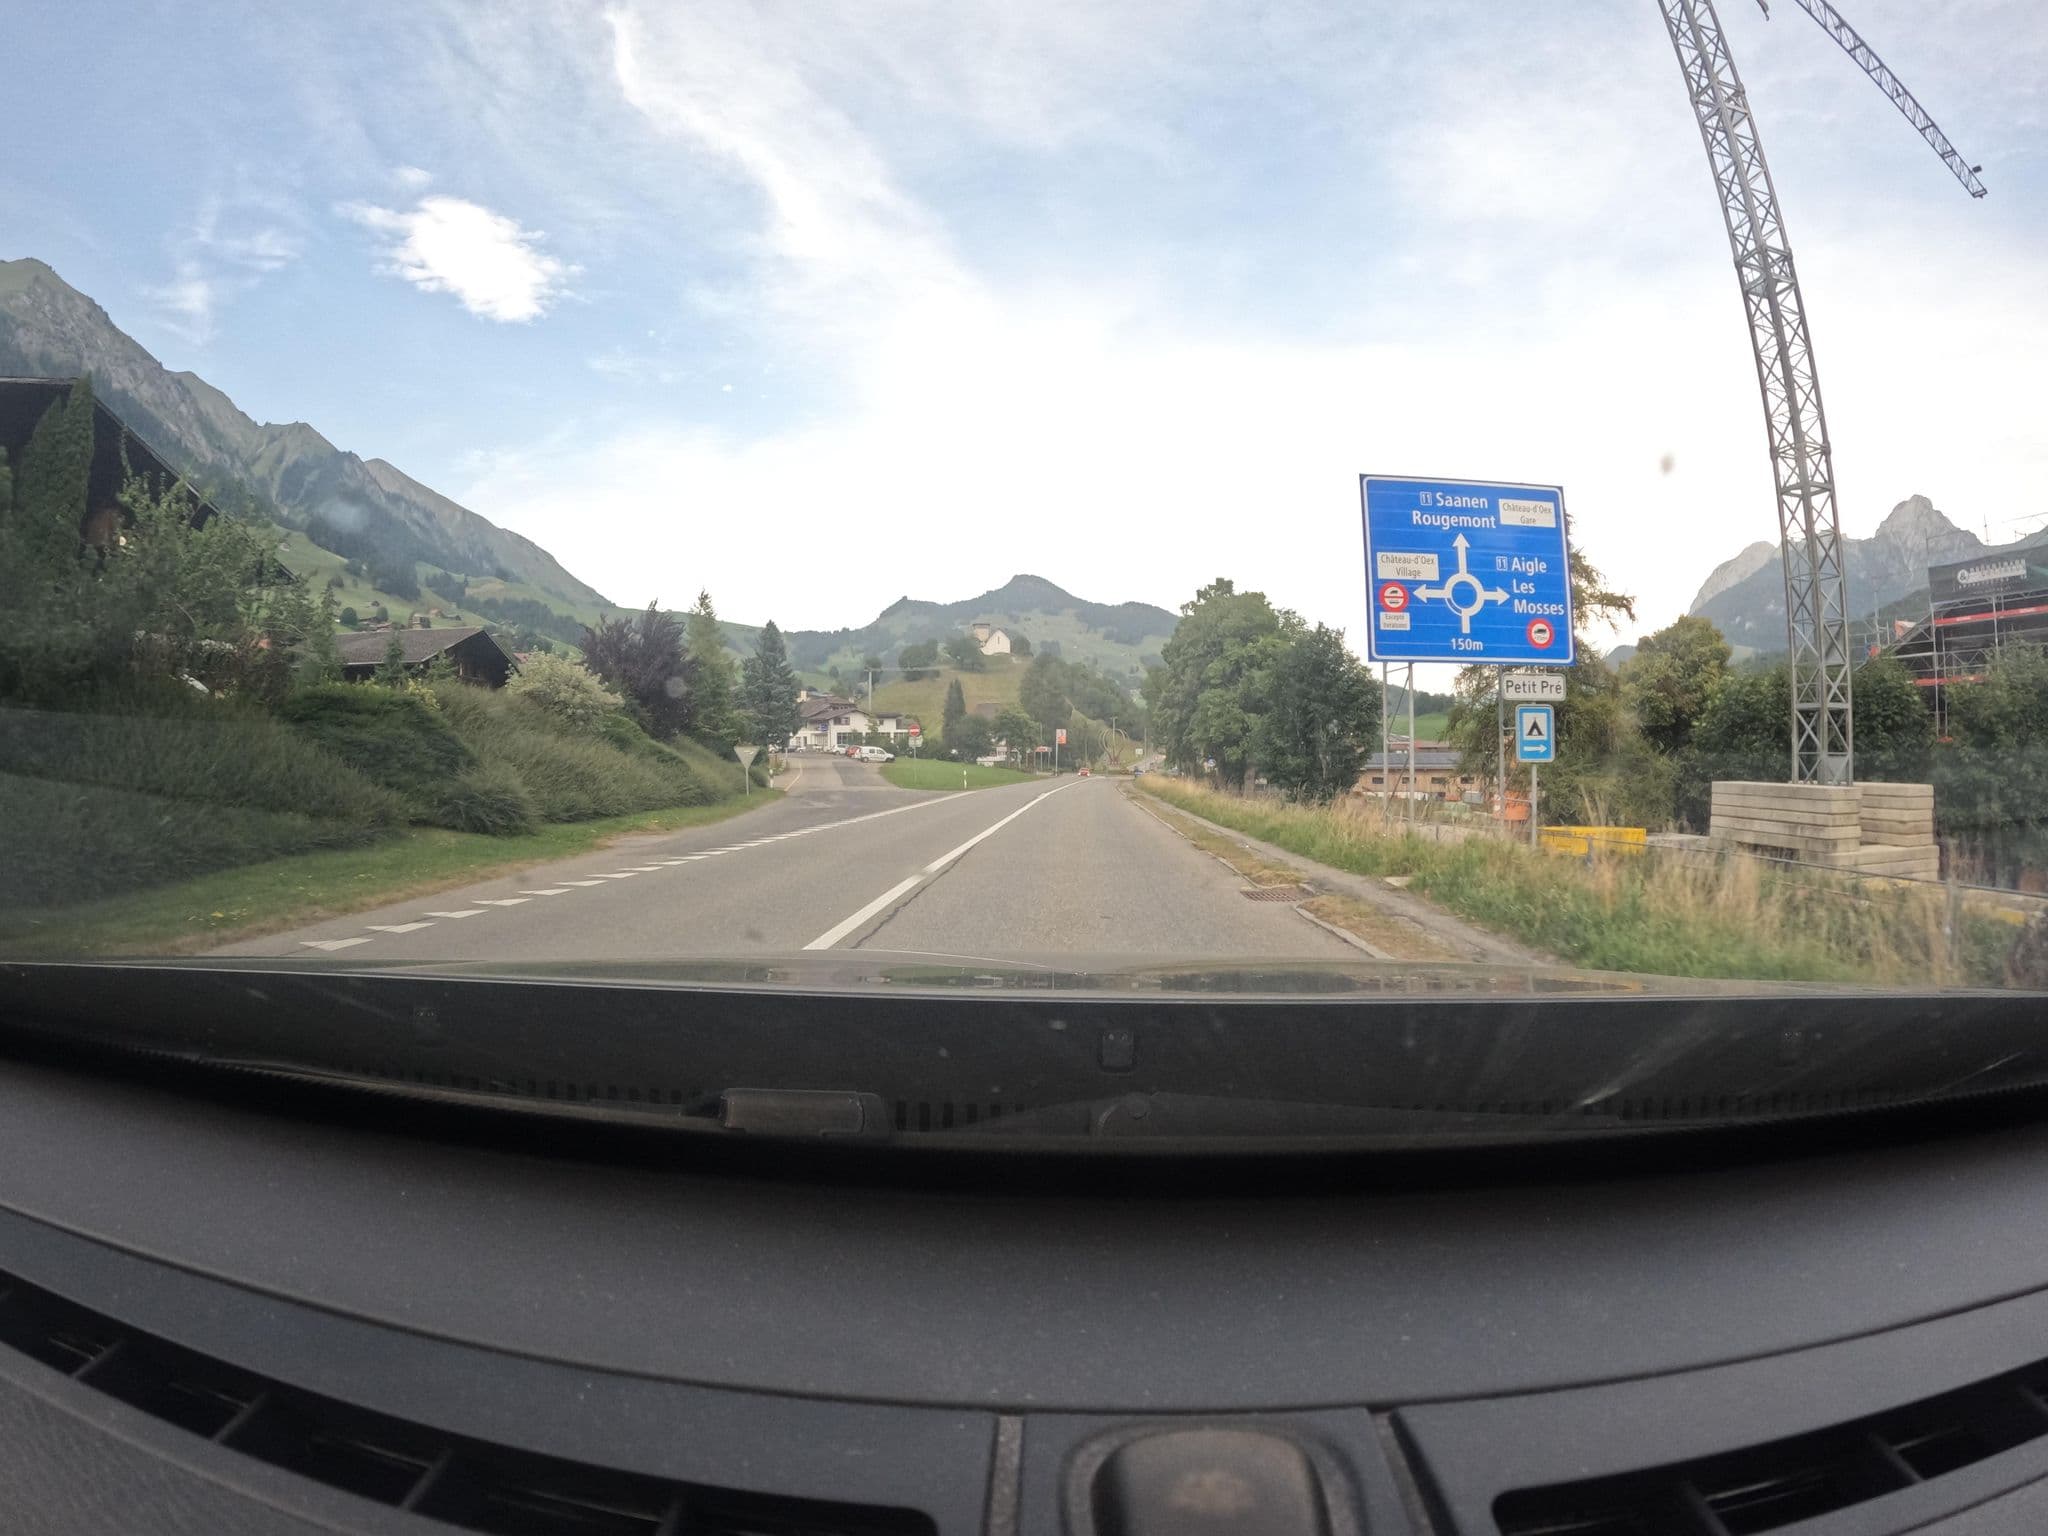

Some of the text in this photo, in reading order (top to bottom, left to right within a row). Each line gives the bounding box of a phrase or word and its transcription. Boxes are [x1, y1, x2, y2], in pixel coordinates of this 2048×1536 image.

[1436, 492, 1488, 509] Saanen
[1502, 502, 1553, 514] Château-d'Oex
[1412, 510, 1496, 530] Rougemont
[1520, 515, 1536, 525] Gare
[1380, 554, 1435, 565] Château-d'Oex
[1511, 557, 1547, 576] Aigle
[1395, 567, 1422, 578] Village
[1512, 578, 1536, 594] Les
[1514, 599, 1565, 616] Mosses
[1451, 638, 1484, 651] 150m
[1505, 680, 1562, 695] Petit Pré
